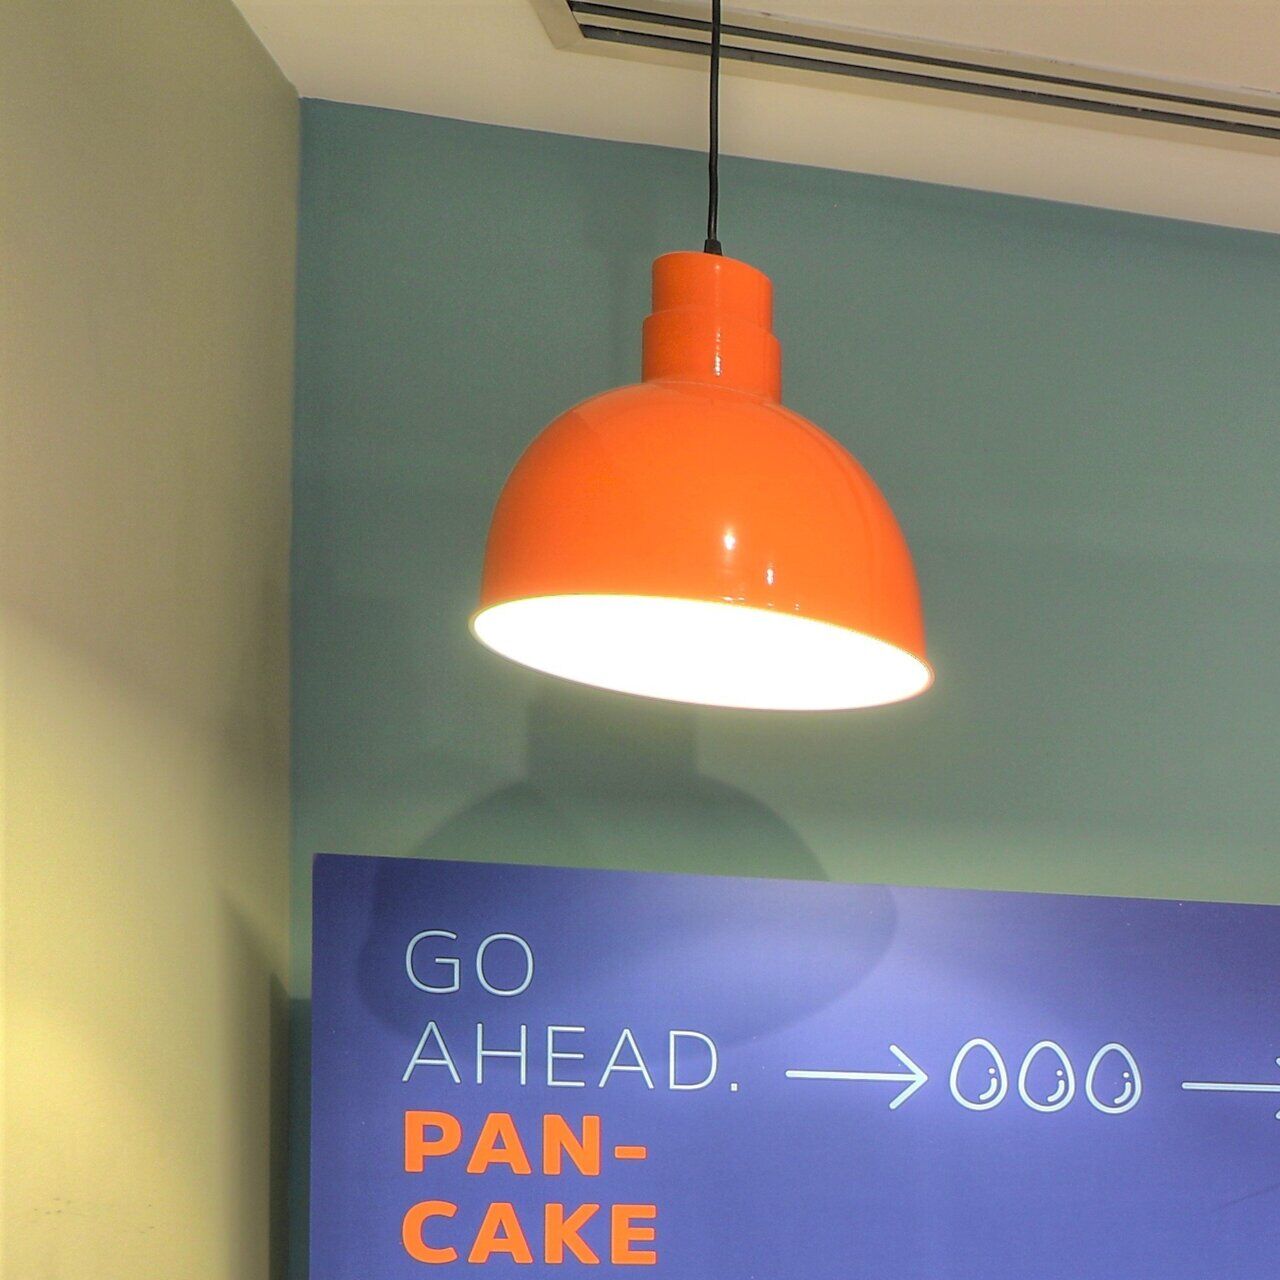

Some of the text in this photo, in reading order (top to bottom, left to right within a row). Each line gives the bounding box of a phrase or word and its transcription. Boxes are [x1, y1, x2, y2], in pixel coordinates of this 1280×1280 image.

[404, 929, 535, 997] GO
[402, 1021, 739, 1092] AHEAD.
[404, 1110, 647, 1176] PAN-
[401, 1200, 657, 1265] CAKE
